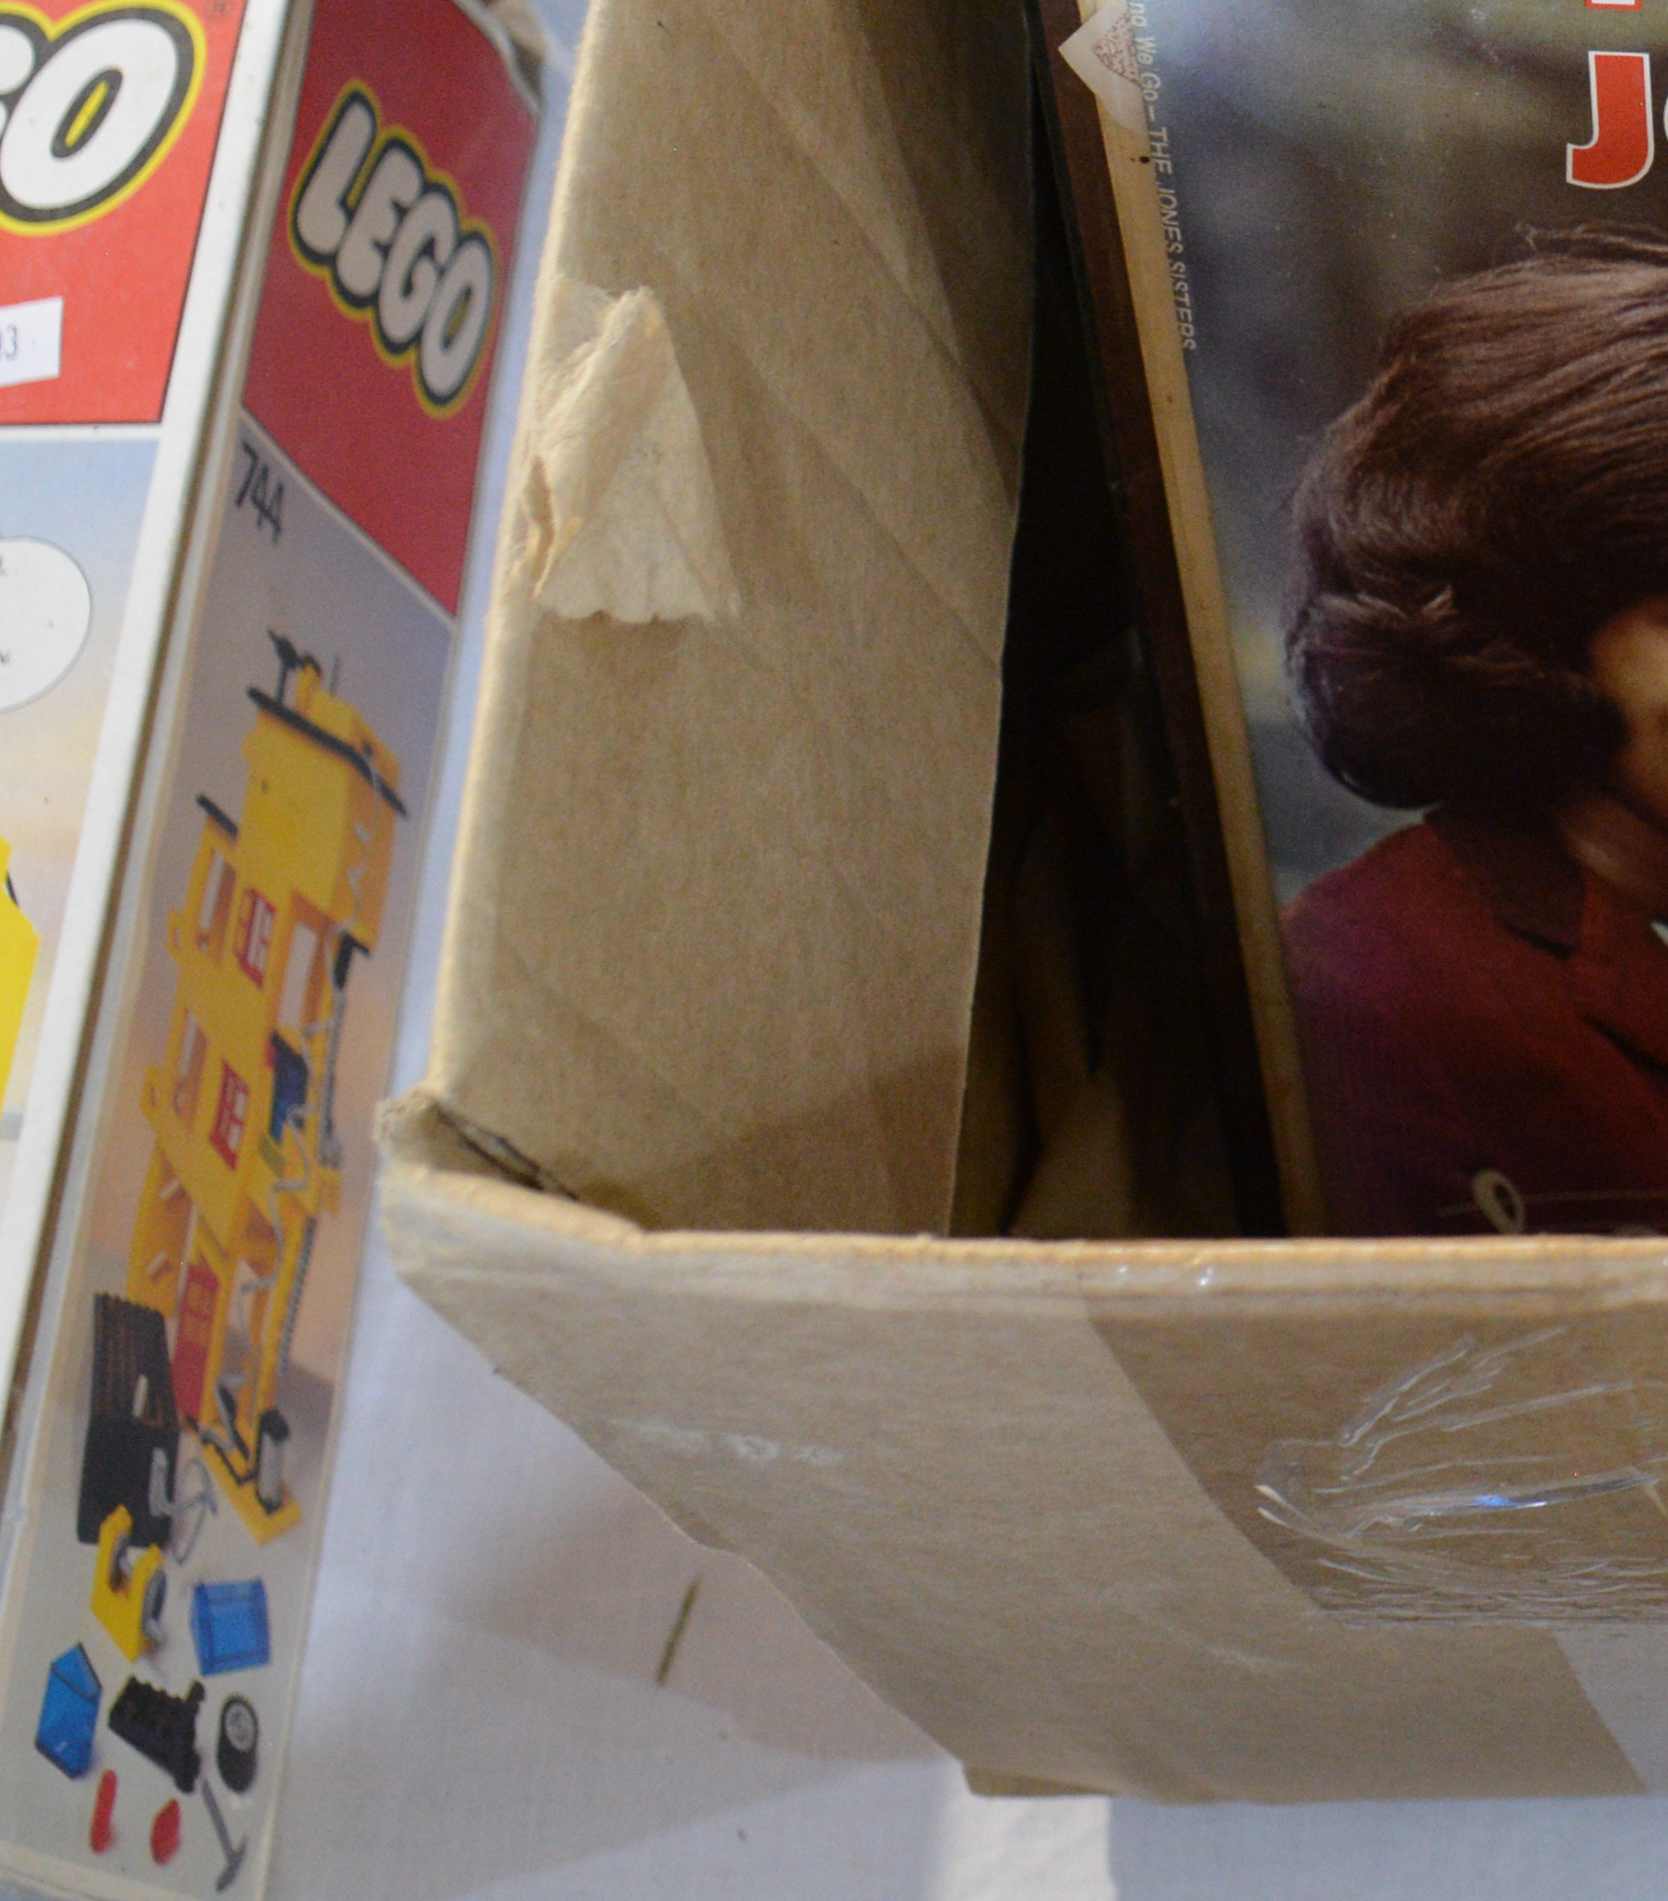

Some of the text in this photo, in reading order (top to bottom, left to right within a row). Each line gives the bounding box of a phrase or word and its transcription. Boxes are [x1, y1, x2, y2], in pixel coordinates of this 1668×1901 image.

[1134, 36, 1157, 66] We
[1141, 72, 1161, 102] Go
[1150, 127, 1174, 176] THE
[293, 91, 495, 404] LEGO
[1156, 181, 1184, 254] JONES
[236, 441, 284, 544] 744
